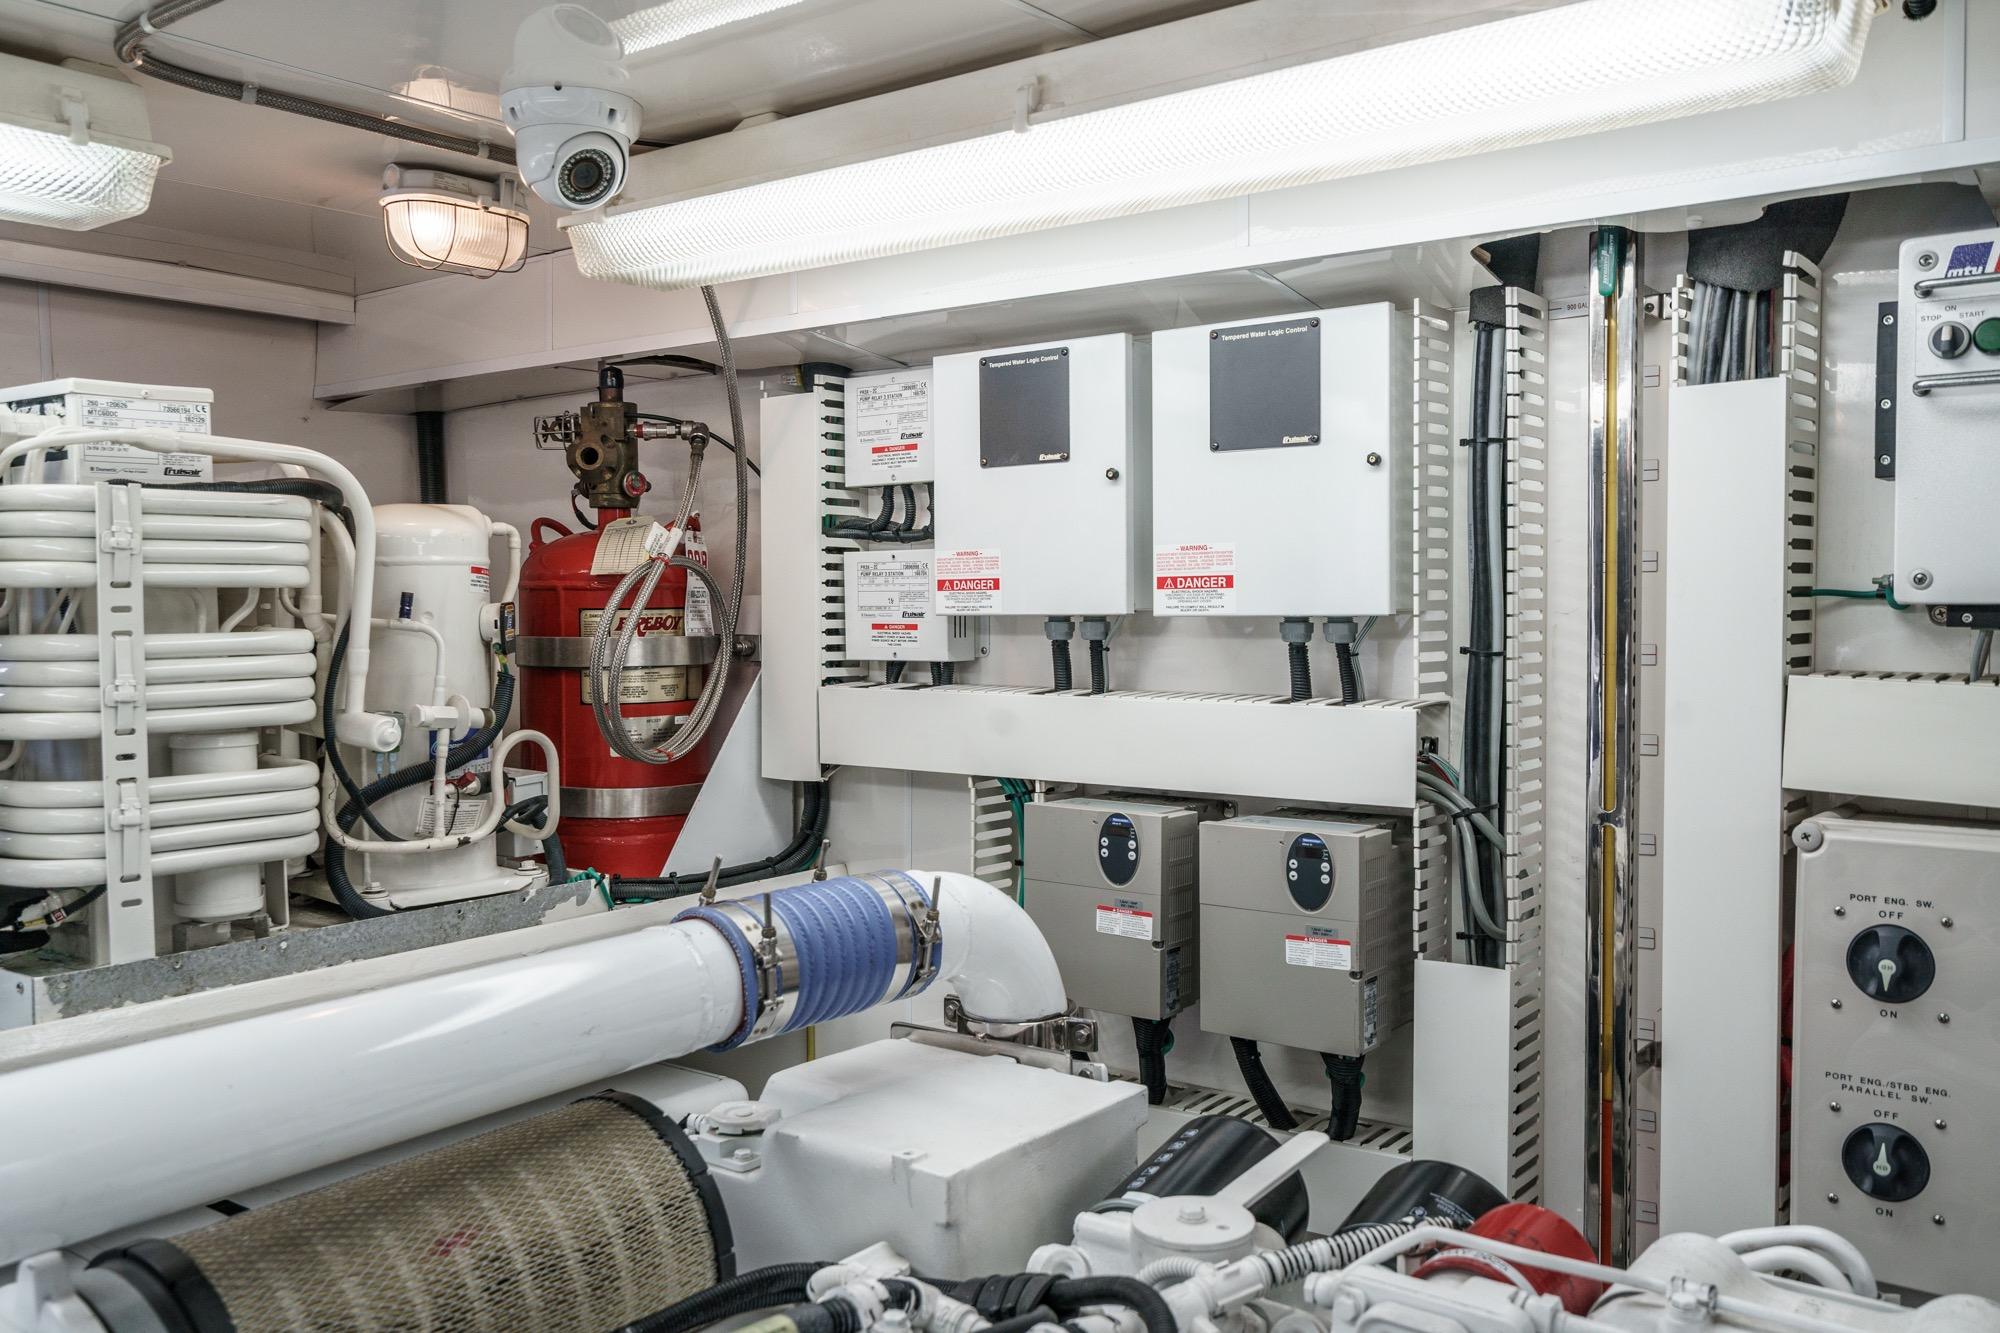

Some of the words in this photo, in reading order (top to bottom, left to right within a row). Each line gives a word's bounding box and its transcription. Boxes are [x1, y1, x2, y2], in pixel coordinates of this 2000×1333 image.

[1947, 266, 1983, 278] mtu
[1960, 310, 1985, 319] START
[1221, 333, 1250, 341] Tempered
[1267, 329, 1284, 337] Logic
[1285, 326, 1308, 334] Control
[989, 360, 1011, 368] Tempered
[1041, 354, 1058, 362] Control
[164, 467, 202, 477] Cruisair
[954, 580, 994, 590] DANGER
[1177, 577, 1227, 588] DANGER
[615, 615, 684, 637] FREBOY
[1850, 894, 1877, 903] PORT
[1884, 897, 1908, 906] ENG.
[1916, 900, 1934, 909] SW.
[1879, 910, 1904, 919] OFF
[1880, 1009, 1897, 1018] ON
[1825, 1071, 1853, 1082] PORT
[1860, 1077, 1918, 1092] ENG./STBD
[1925, 1086, 1951, 1098] ENG.
[1841, 1084, 1901, 1100] PARALLEL
[1911, 1095, 1932, 1104] SW.
[1873, 1109, 1899, 1120] OFF
[1875, 1207, 1893, 1217] ON
